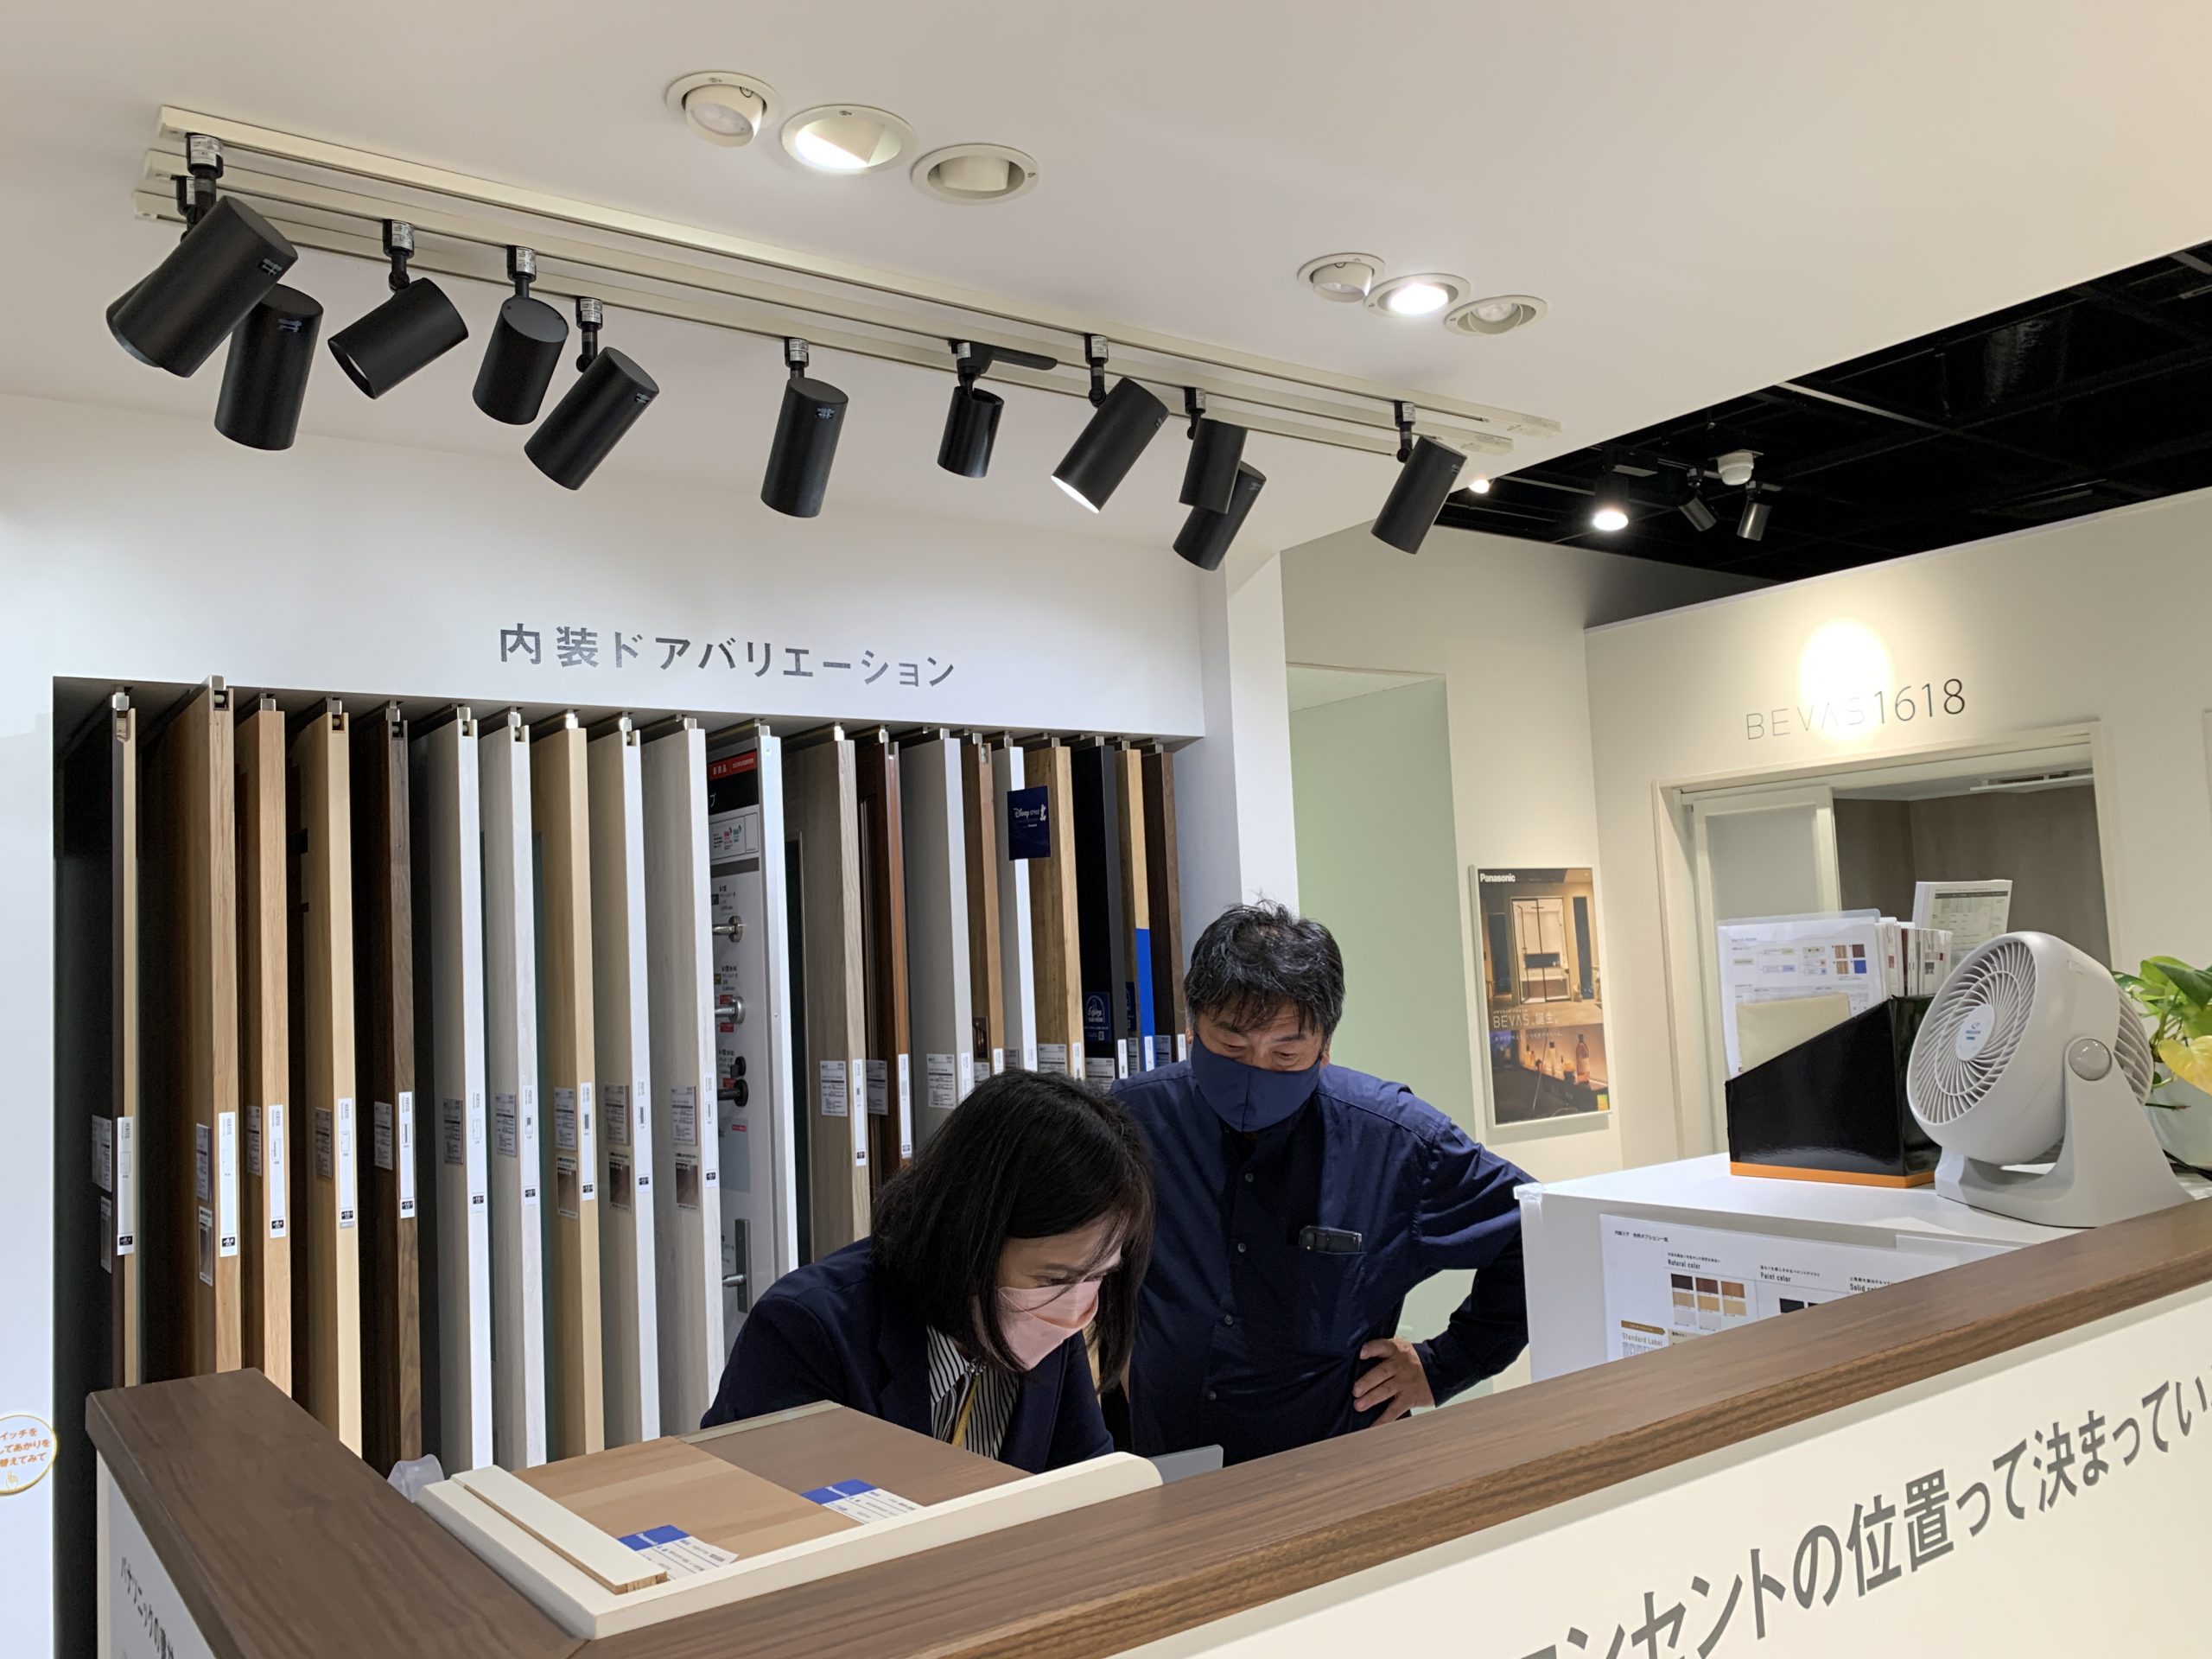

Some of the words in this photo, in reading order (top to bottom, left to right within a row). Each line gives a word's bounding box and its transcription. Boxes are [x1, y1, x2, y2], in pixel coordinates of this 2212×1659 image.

[499, 622, 954, 688] 内装ドアバリエーション
[1479, 873, 1516, 883] Panasonic
[1668, 1259, 1686, 1268] Natural
[1760, 1272, 1775, 1281] Paint
[1622, 1332, 1647, 1344] Standard
[1648, 1337, 1663, 1347] Label
